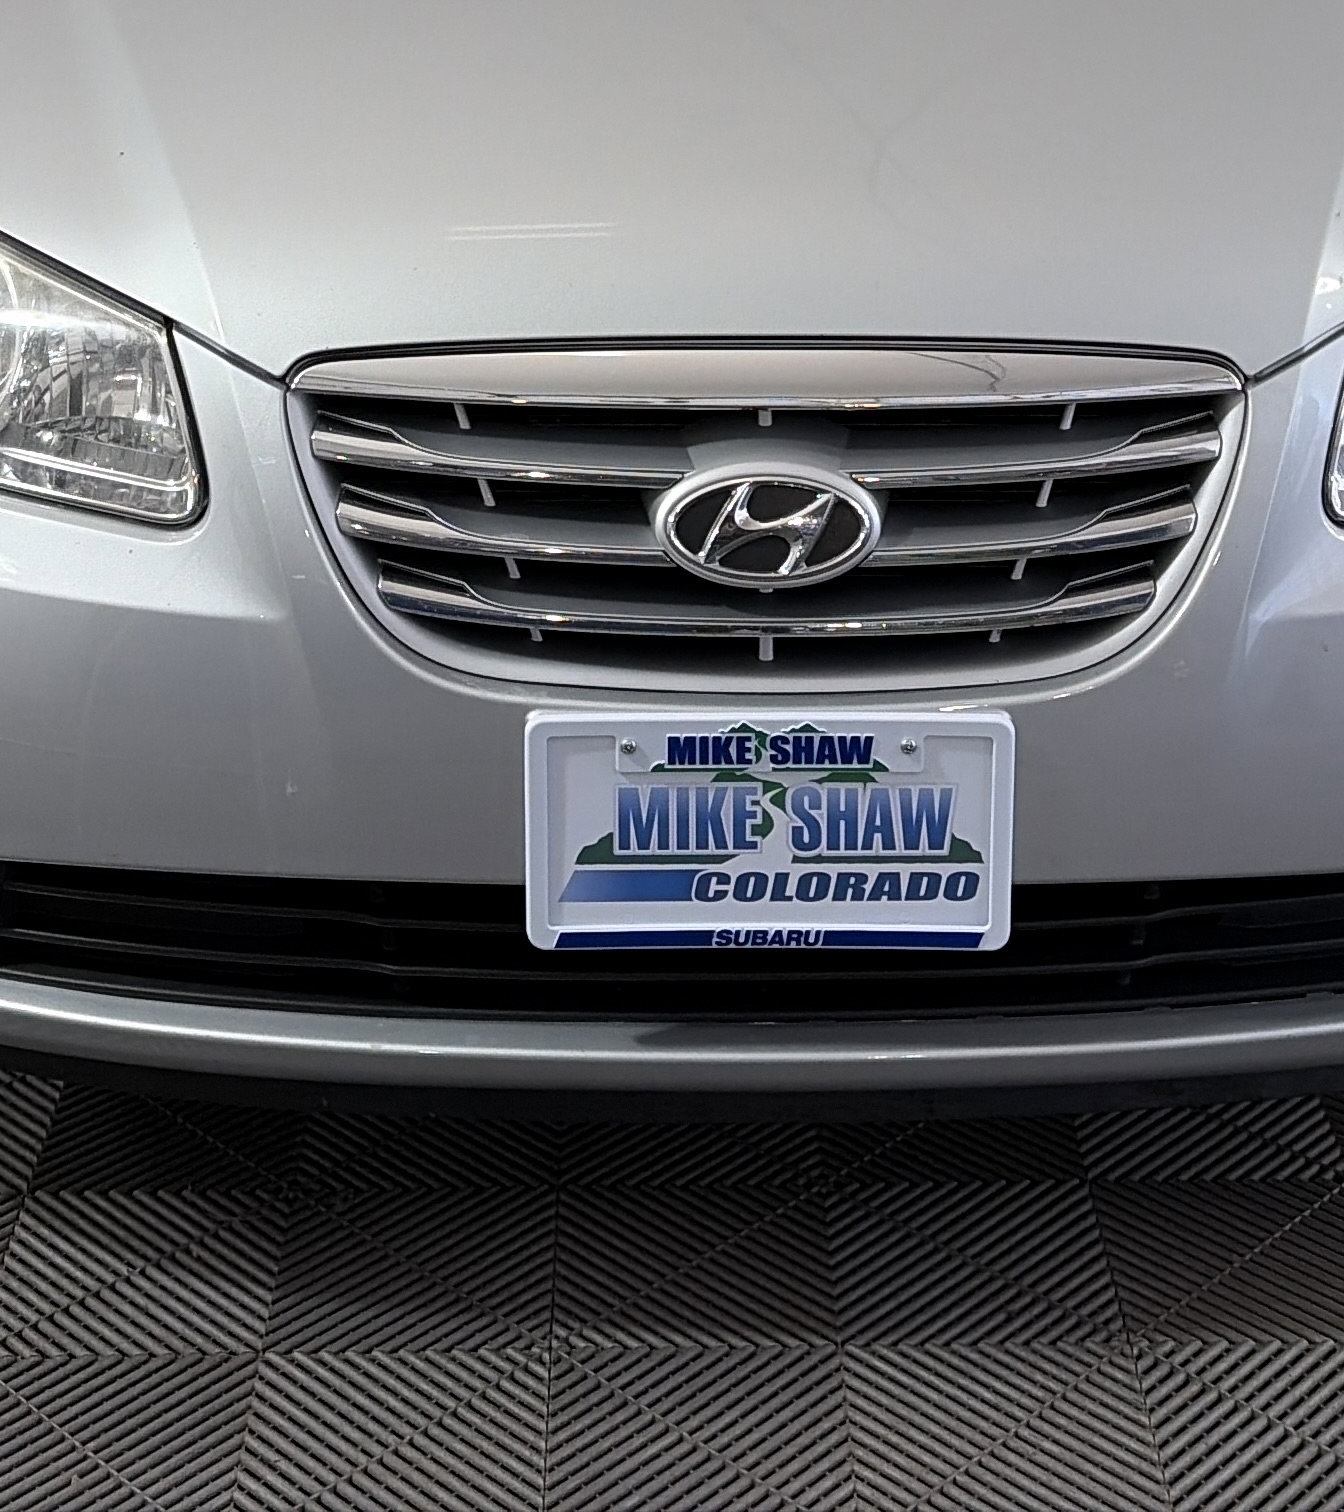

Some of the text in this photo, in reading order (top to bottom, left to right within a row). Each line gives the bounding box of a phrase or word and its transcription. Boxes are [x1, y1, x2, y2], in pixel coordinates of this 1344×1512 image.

[666, 734, 875, 766] MIKE SHAW
[616, 785, 955, 853] MIKE SHAW
[693, 870, 981, 903] COLORADO
[713, 928, 823, 948] SUBARU
